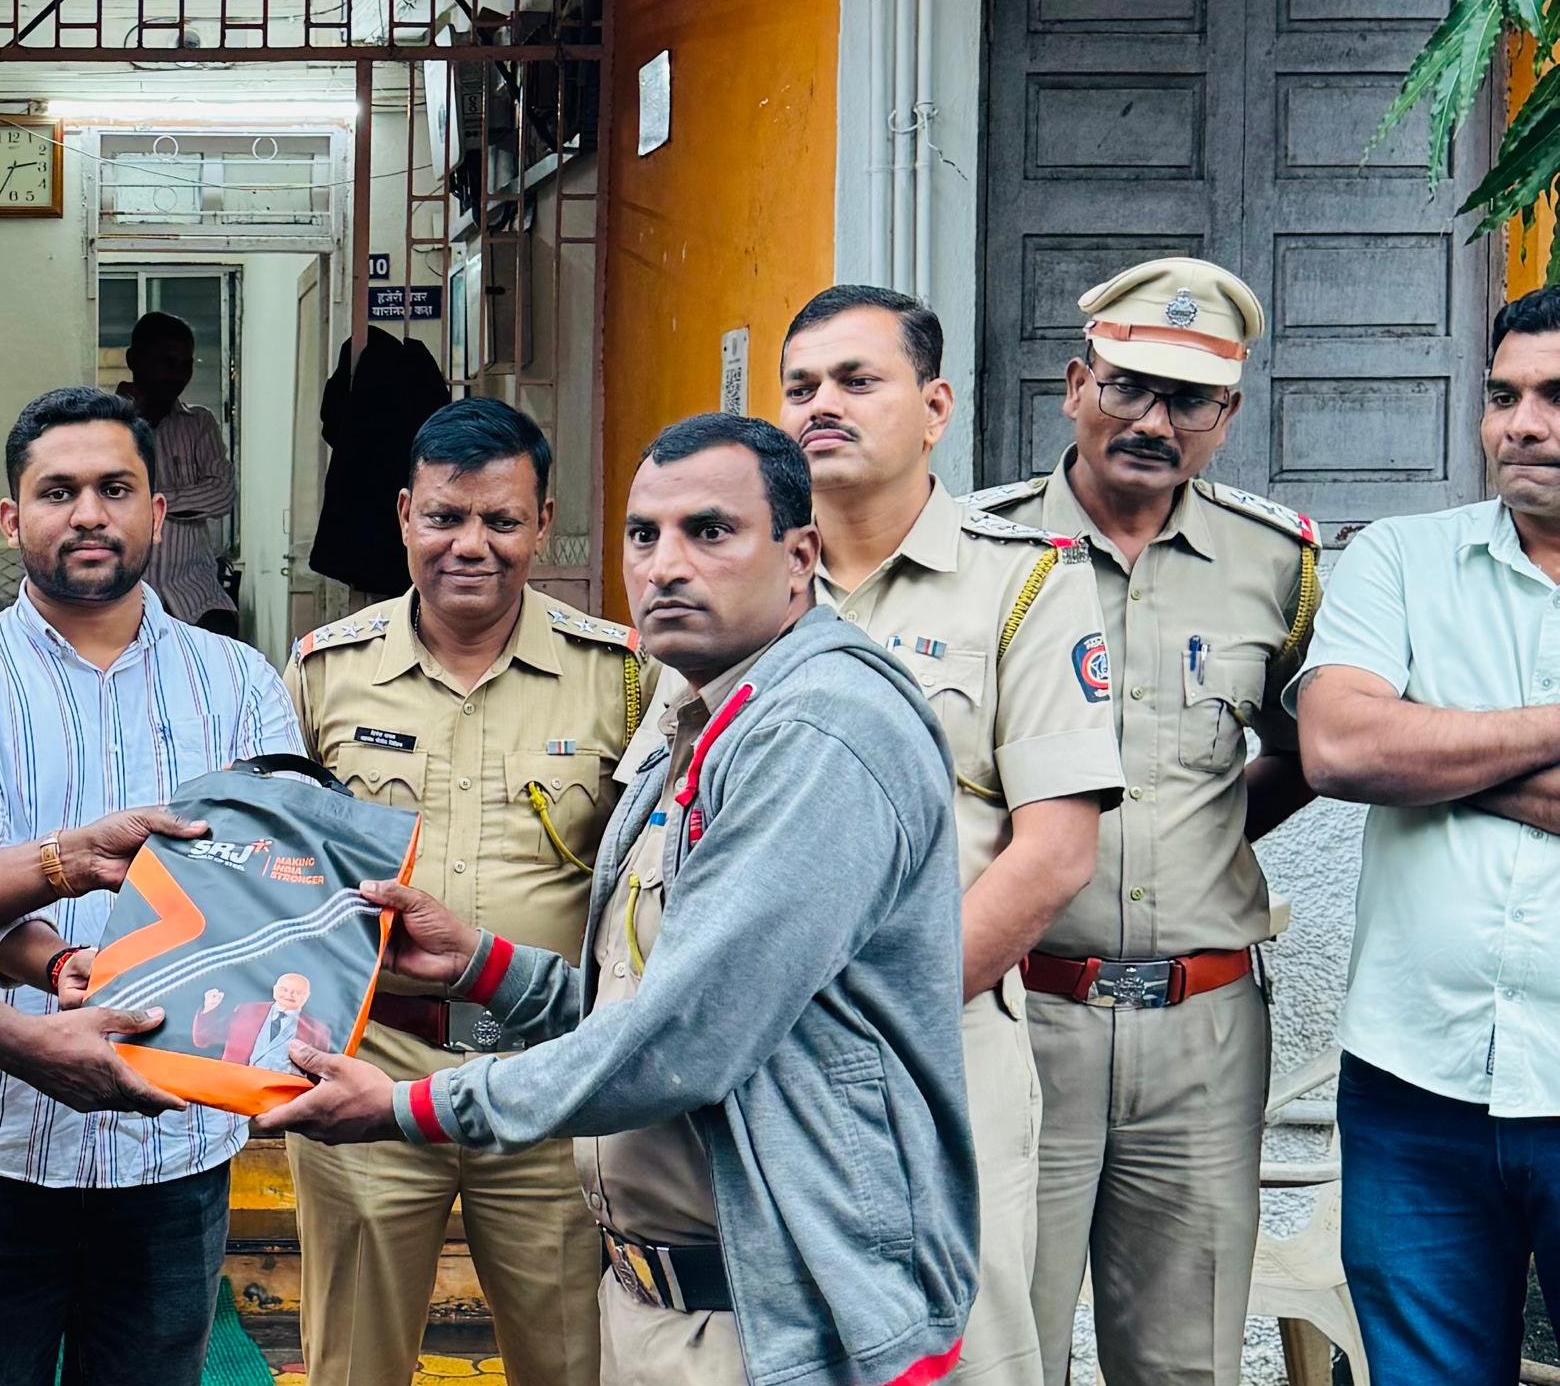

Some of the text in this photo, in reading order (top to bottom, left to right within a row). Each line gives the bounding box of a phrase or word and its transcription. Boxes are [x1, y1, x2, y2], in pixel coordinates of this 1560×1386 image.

[8, 131, 20, 143] 12
[38, 145, 46, 156] 2
[37, 161, 47, 173] 3
[25, 190, 35, 202] 5
[190, 840, 254, 864] SRJ
[275, 856, 315, 867] MAKING
[273, 864, 302, 875] INDIA
[270, 871, 324, 885] STRONGER
